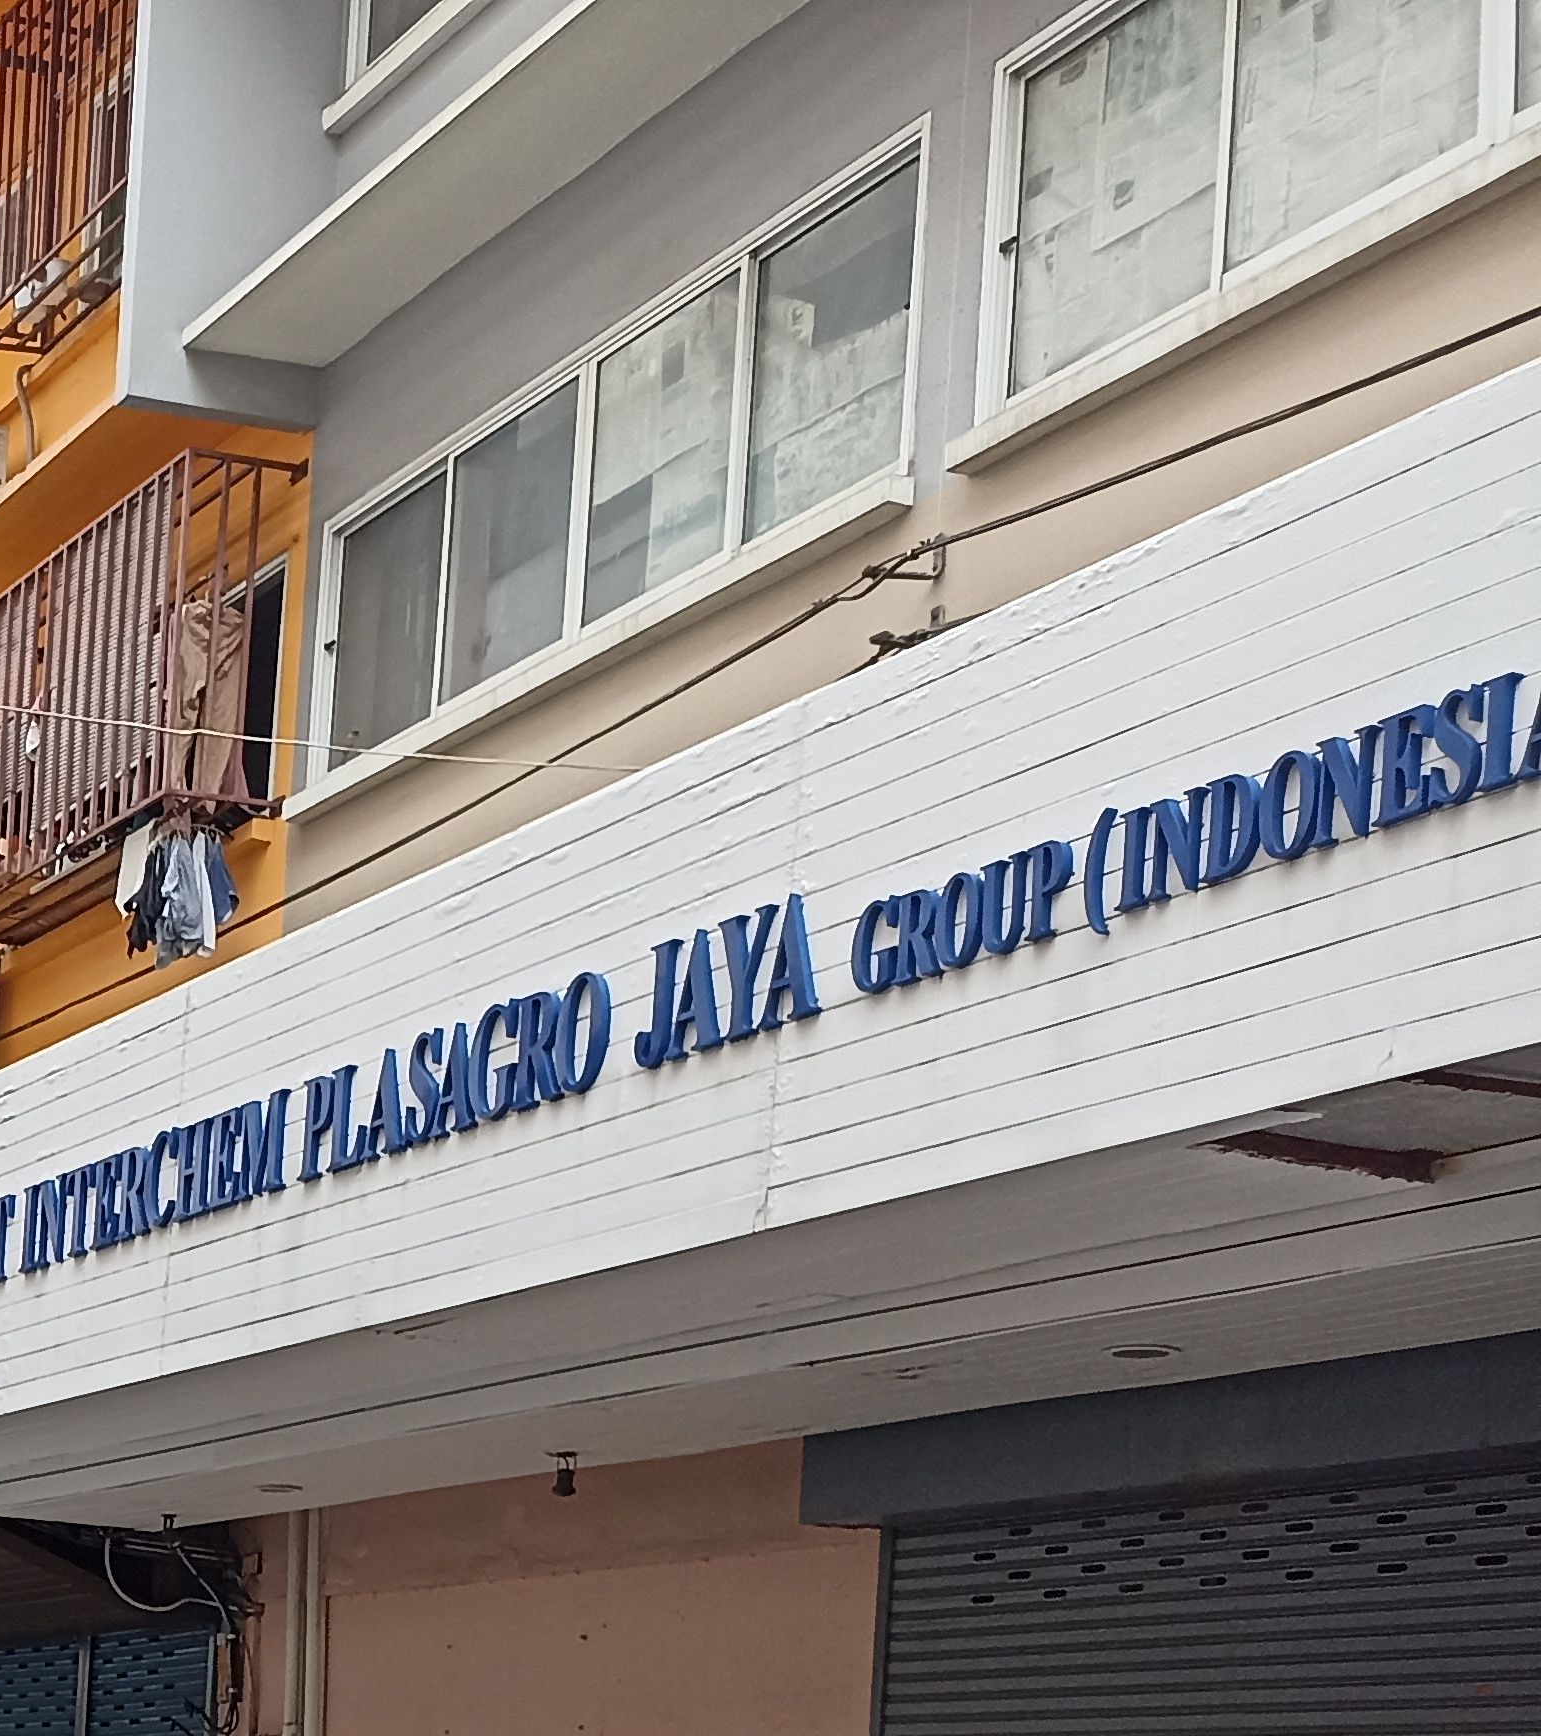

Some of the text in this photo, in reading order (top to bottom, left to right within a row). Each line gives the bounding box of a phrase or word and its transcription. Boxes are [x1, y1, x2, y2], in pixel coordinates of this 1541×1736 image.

[19, 1088, 293, 1272] INTERCHEM
[302, 971, 614, 1181] PLASAGRO
[634, 893, 823, 1070] JAYA
[852, 840, 1076, 993] GROUP
[1084, 671, 1541, 935] (INDONESI
